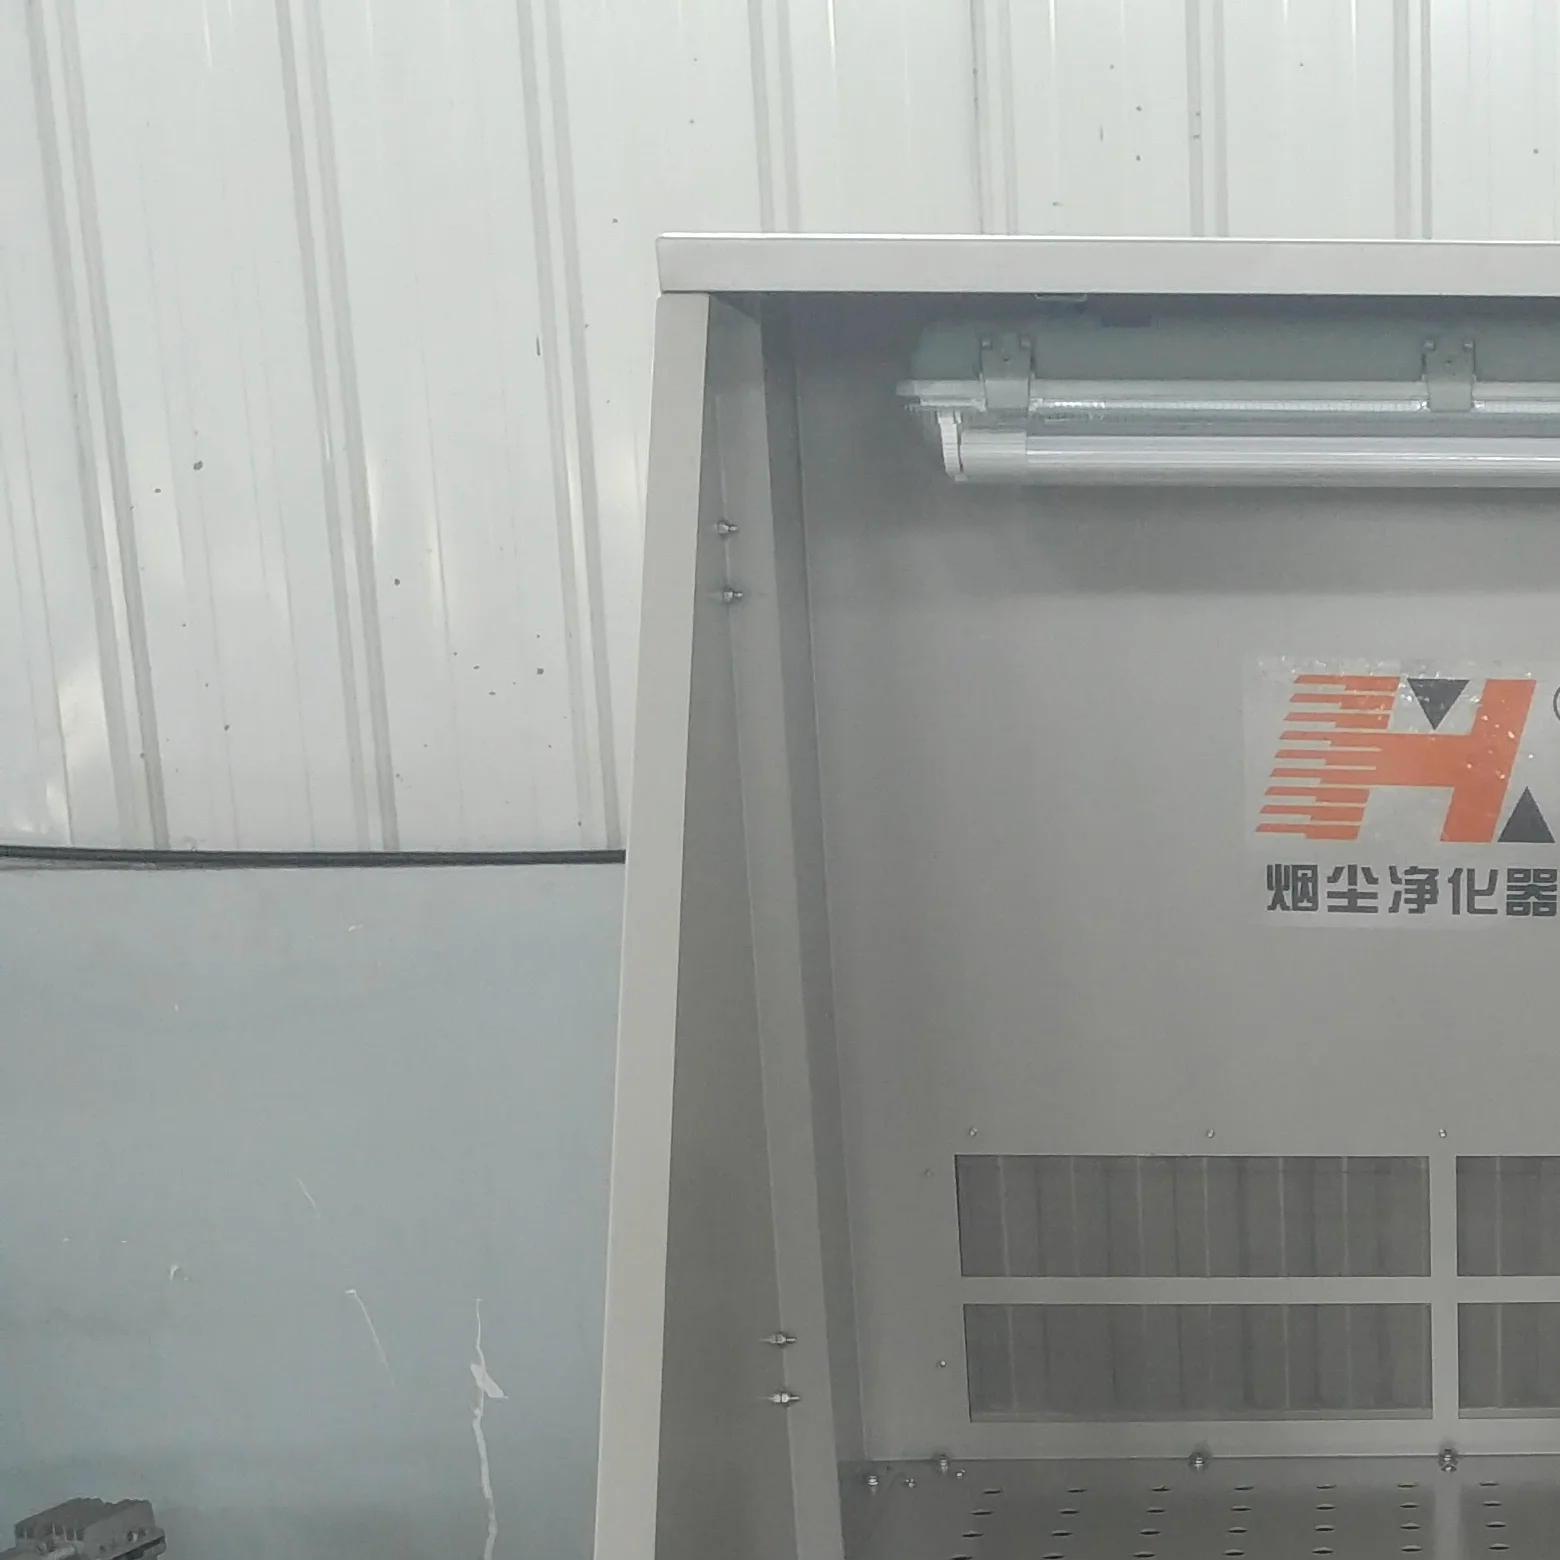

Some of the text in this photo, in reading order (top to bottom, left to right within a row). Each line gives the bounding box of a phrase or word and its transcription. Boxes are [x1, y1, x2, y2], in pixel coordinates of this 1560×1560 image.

[1266, 862, 1558, 917] 烟尘净化器
